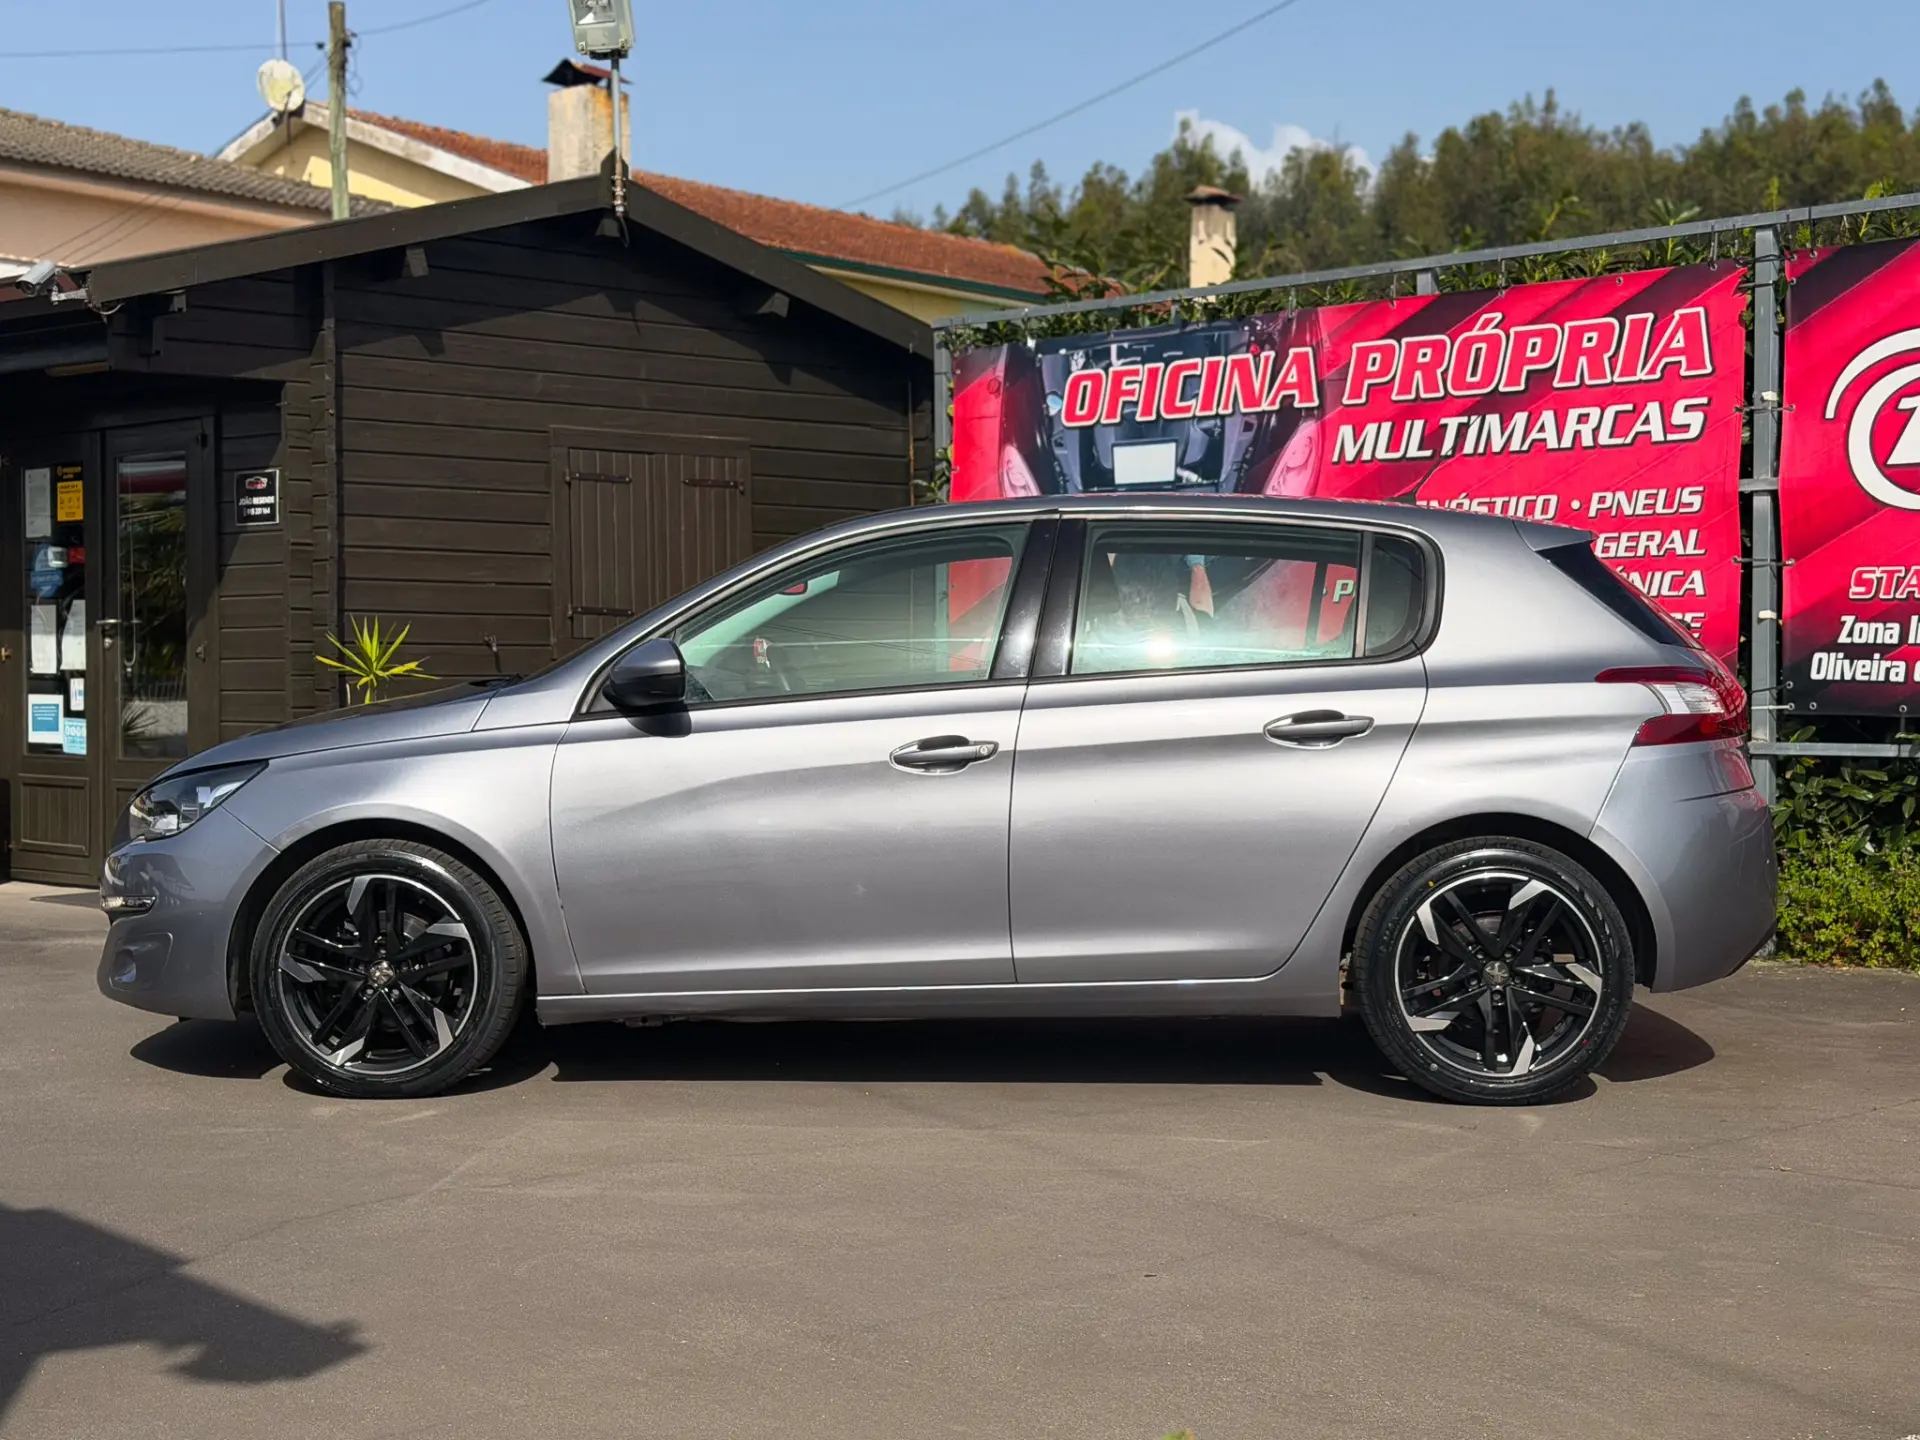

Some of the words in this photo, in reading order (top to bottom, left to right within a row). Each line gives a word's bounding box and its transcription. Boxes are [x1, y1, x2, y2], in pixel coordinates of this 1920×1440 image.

[1061, 346, 1319, 428] OFICINA
[1342, 307, 1712, 404] PRÓPRIA
[1331, 397, 1710, 464] MULTIMARCAS
[1416, 492, 1558, 520] ÓSTICO
[1588, 486, 1705, 517] PNEUS
[1595, 529, 1706, 559] GERAL
[1332, 579, 1355, 603] P
[1616, 566, 1705, 597] NICA
[1849, 566, 1920, 599] STA
[1837, 615, 1900, 644] Zona
[1908, 615, 1920, 644] I
[1810, 652, 1906, 682] Oliveira
